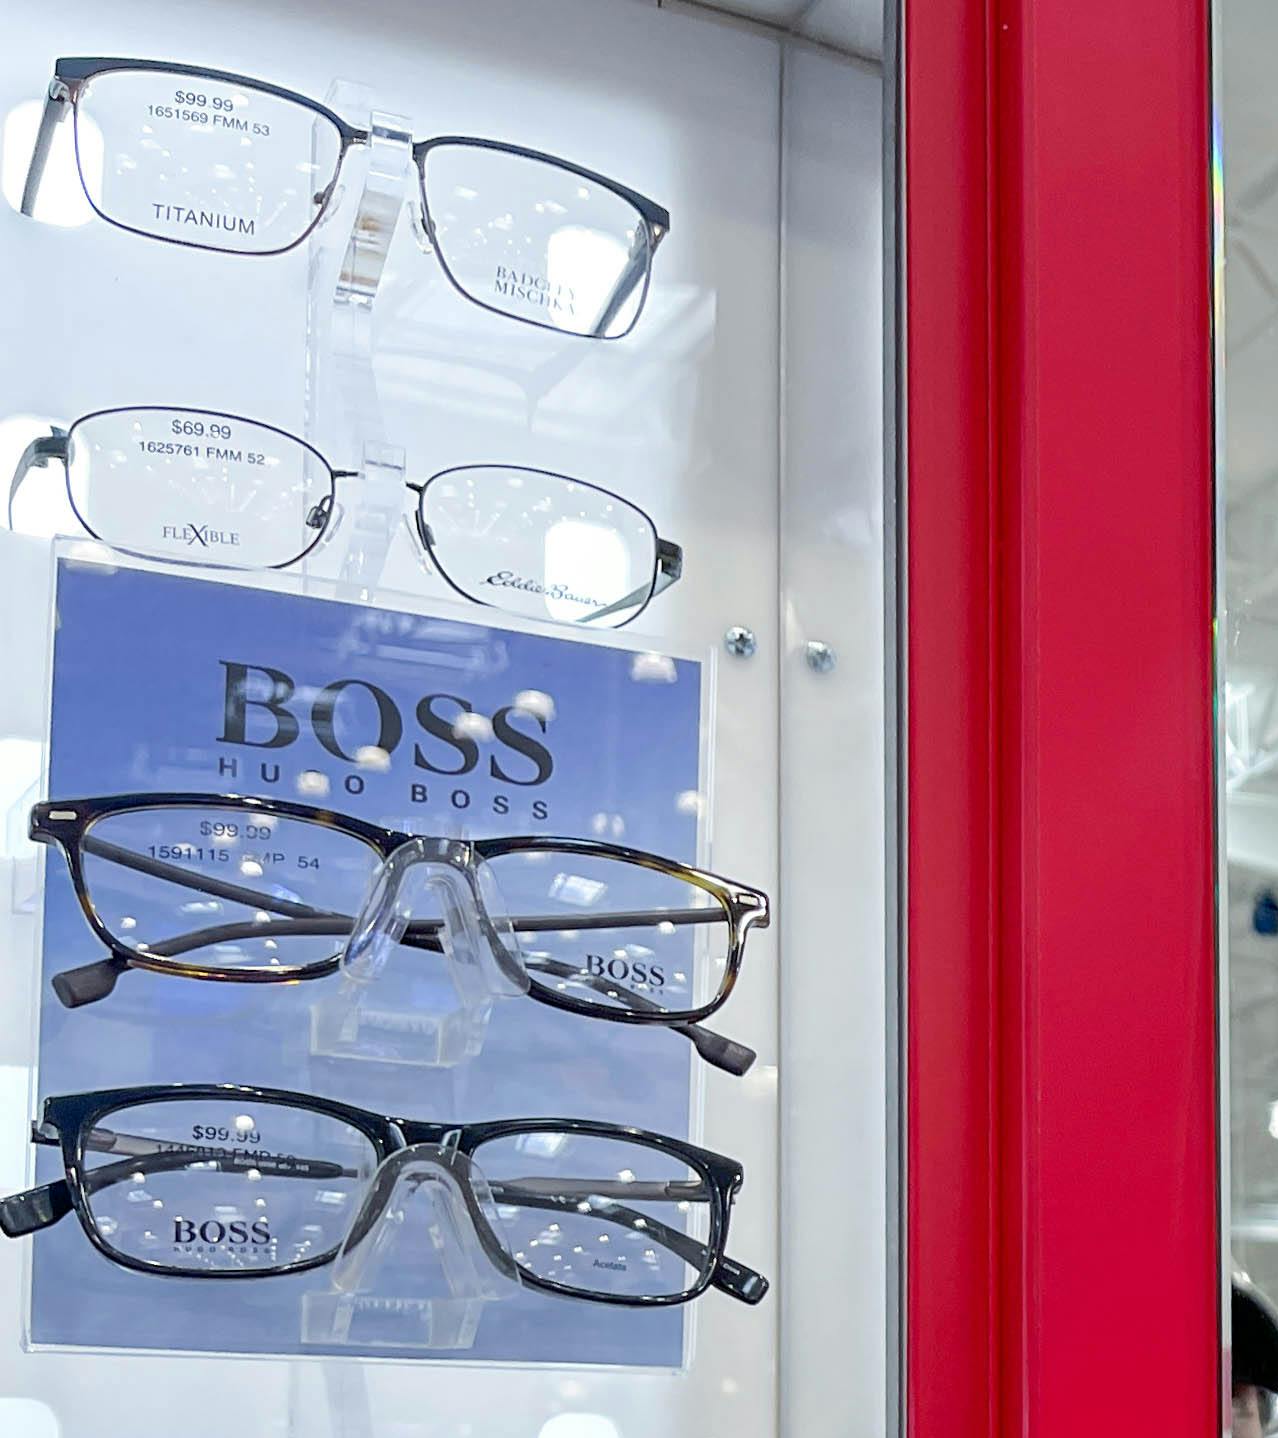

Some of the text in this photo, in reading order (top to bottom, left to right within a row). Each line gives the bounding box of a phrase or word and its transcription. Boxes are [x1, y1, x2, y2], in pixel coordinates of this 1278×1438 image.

[174, 90, 234, 112] $99.99
[147, 104, 270, 136] 1651569 FMM 53
[152, 203, 254, 235] TITANIUM
[171, 418, 232, 440] $69.99
[139, 441, 265, 465] 1625761 FMM 52
[162, 523, 240, 548] FLEXIBLE
[216, 659, 553, 787] BOSS
[219, 757, 548, 821] HUO BOSS
[149, 845, 229, 862] 1591115
[297, 855, 319, 870] 54
[586, 953, 664, 987] BOSS
[192, 1124, 261, 1144] $99.99
[173, 1219, 271, 1245] BOSS
